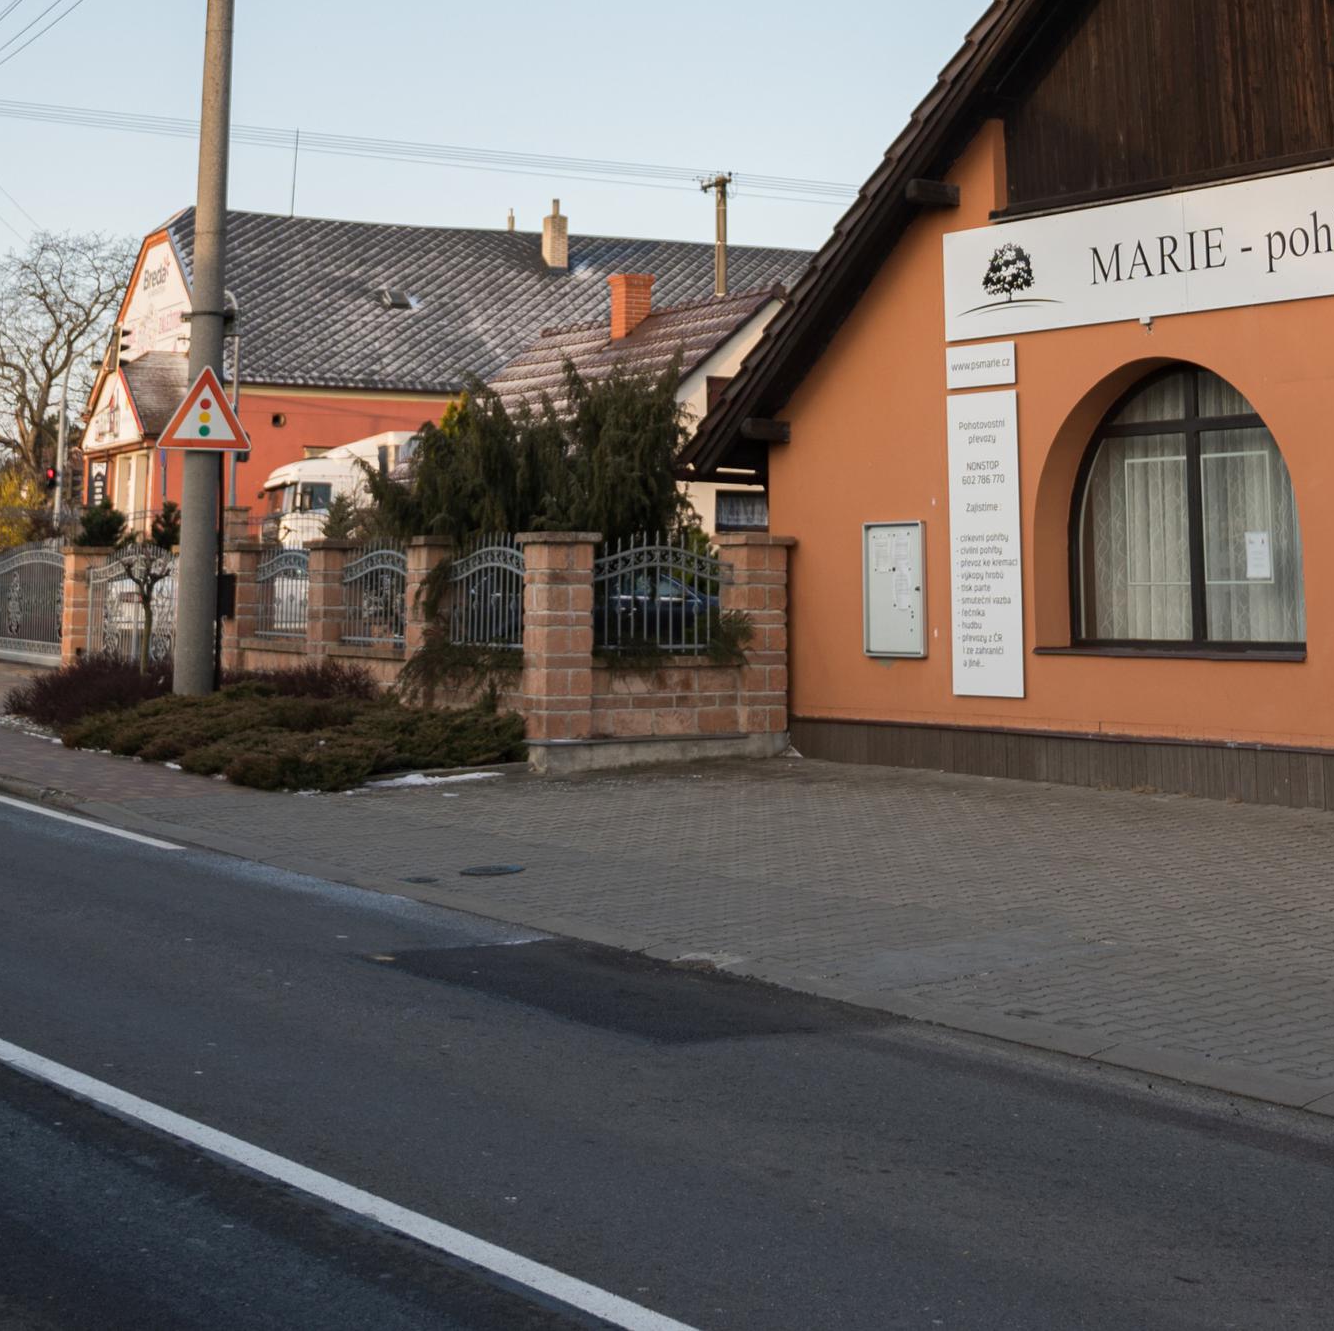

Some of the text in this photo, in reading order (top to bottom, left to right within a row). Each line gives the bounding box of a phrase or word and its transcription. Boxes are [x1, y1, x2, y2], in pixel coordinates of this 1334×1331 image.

[1089, 226, 1227, 286] MARIE
[1240, 245, 1253, 253] -
[951, 357, 1010, 372] www.psmarie.cz
[966, 460, 999, 471] NONSTOP
[961, 476, 976, 485] 602
[992, 474, 1005, 483] 770
